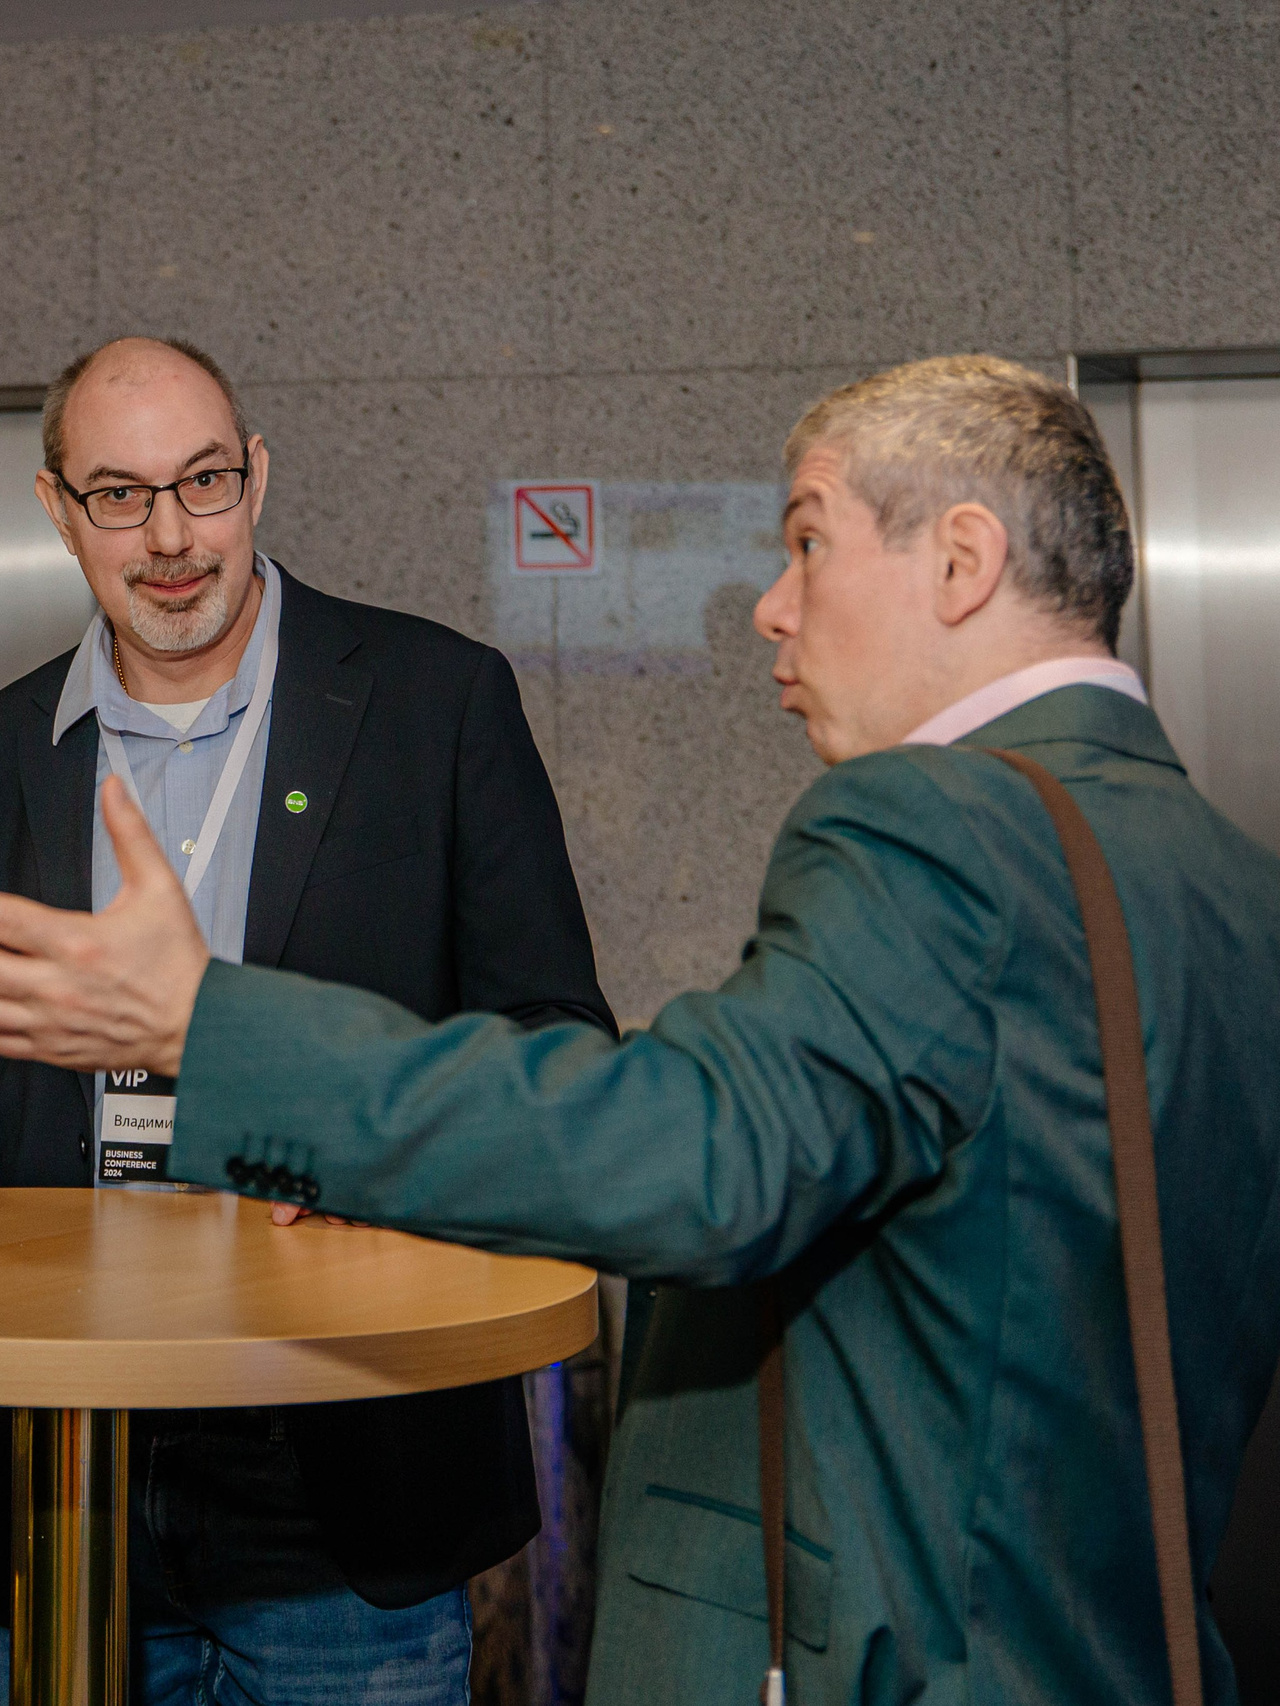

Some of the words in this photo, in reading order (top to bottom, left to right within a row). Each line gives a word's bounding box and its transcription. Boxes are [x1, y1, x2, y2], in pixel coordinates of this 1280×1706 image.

[111, 1069, 148, 1087] VIP
[114, 1114, 173, 1130] Владими
[105, 1150, 143, 1159] BUSINESS
[104, 1160, 157, 1169] CONFERENCE
[103, 1169, 122, 1177] 2024
